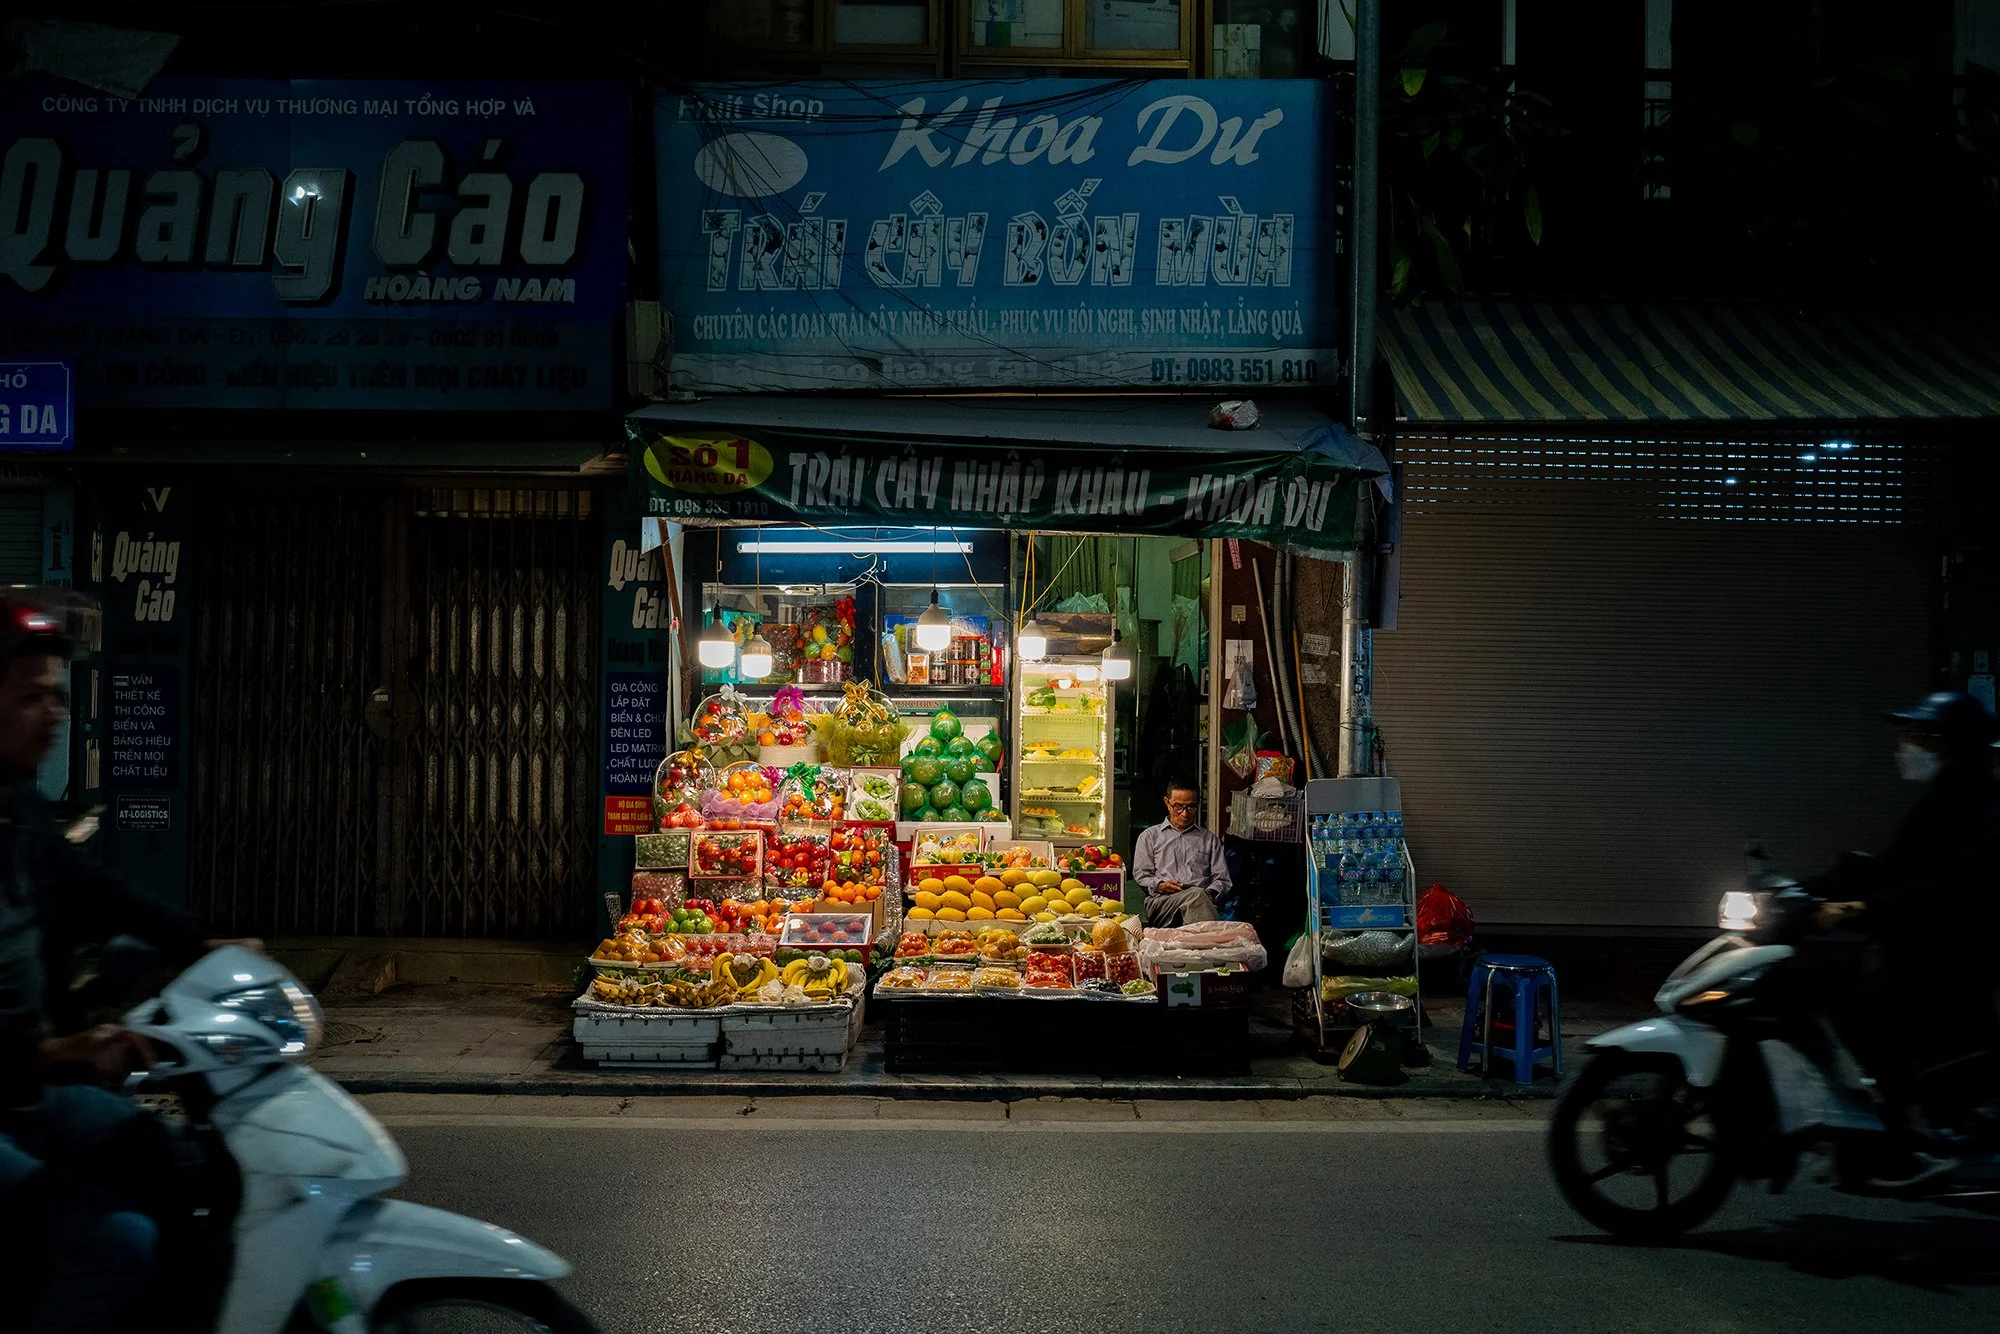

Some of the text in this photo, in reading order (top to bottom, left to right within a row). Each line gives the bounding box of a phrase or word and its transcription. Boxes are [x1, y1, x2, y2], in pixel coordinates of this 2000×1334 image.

[41, 91, 536, 119] CÔNG TY TNHH DỊCH VỤ THƯƠNG MẠI TỔNG HỢP VÀ
[677, 93, 824, 124] Fruit Shop
[877, 94, 1284, 173] Khoa Dư
[0, 123, 585, 301] Quảng Cáo
[702, 178, 1295, 291] TRÁI CÂY BỐN MÙA
[363, 271, 576, 303] HOÀNG NAM
[693, 306, 754, 340] CHUYÊN
[757, 306, 788, 339] CÁC
[791, 313, 828, 343] LOẠI
[829, 305, 865, 337] TRÁI
[870, 304, 899, 337] CÂY
[946, 296, 989, 336] KHẨU
[1141, 309, 1177, 334] SINH
[1271, 300, 1304, 340] QUẢ
[535, 361, 588, 393] LIỆU
[1151, 358, 1181, 382] ĐT:
[1187, 358, 1235, 382] 0983
[1240, 358, 1274, 382] 551
[1282, 359, 1317, 382] 810
[20, 404, 57, 434] DA
[670, 439, 750, 469] SỐ 1
[723, 472, 748, 485] DA
[789, 445, 866, 507] TRÁI
[875, 443, 944, 510] CÂY
[950, 448, 1046, 524] NHẬP
[1184, 473, 1278, 525] KHOA
[1283, 473, 1341, 532] DƯ
[648, 497, 671, 513] ĐT:
[111, 531, 181, 584] Quảng
[134, 579, 176, 622] Cáo
[113, 687, 162, 701] THIẾT KẾ
[611, 681, 659, 693] GIA CÔNG
[113, 703, 165, 716] THI CÔNG
[611, 694, 651, 710] LẮP ĐẶT
[113, 717, 155, 731] BIỂN VÀ
[610, 709, 633, 723] BIỂN
[635, 713, 642, 723] &
[610, 725, 652, 738] ĐÈN LED
[113, 732, 171, 749] BẢNG HIỆU
[610, 744, 667, 753] LED MATRIX
[113, 748, 165, 764] TRÊN MỌI
[610, 756, 636, 768] CHẤT
[112, 763, 168, 780] CHẤT LIỆU
[609, 770, 653, 783] HOÀN HẢ
[119, 810, 168, 819] AT-LOGISTICS
[621, 812, 630, 820] GIA
[615, 824, 622, 833] AN
